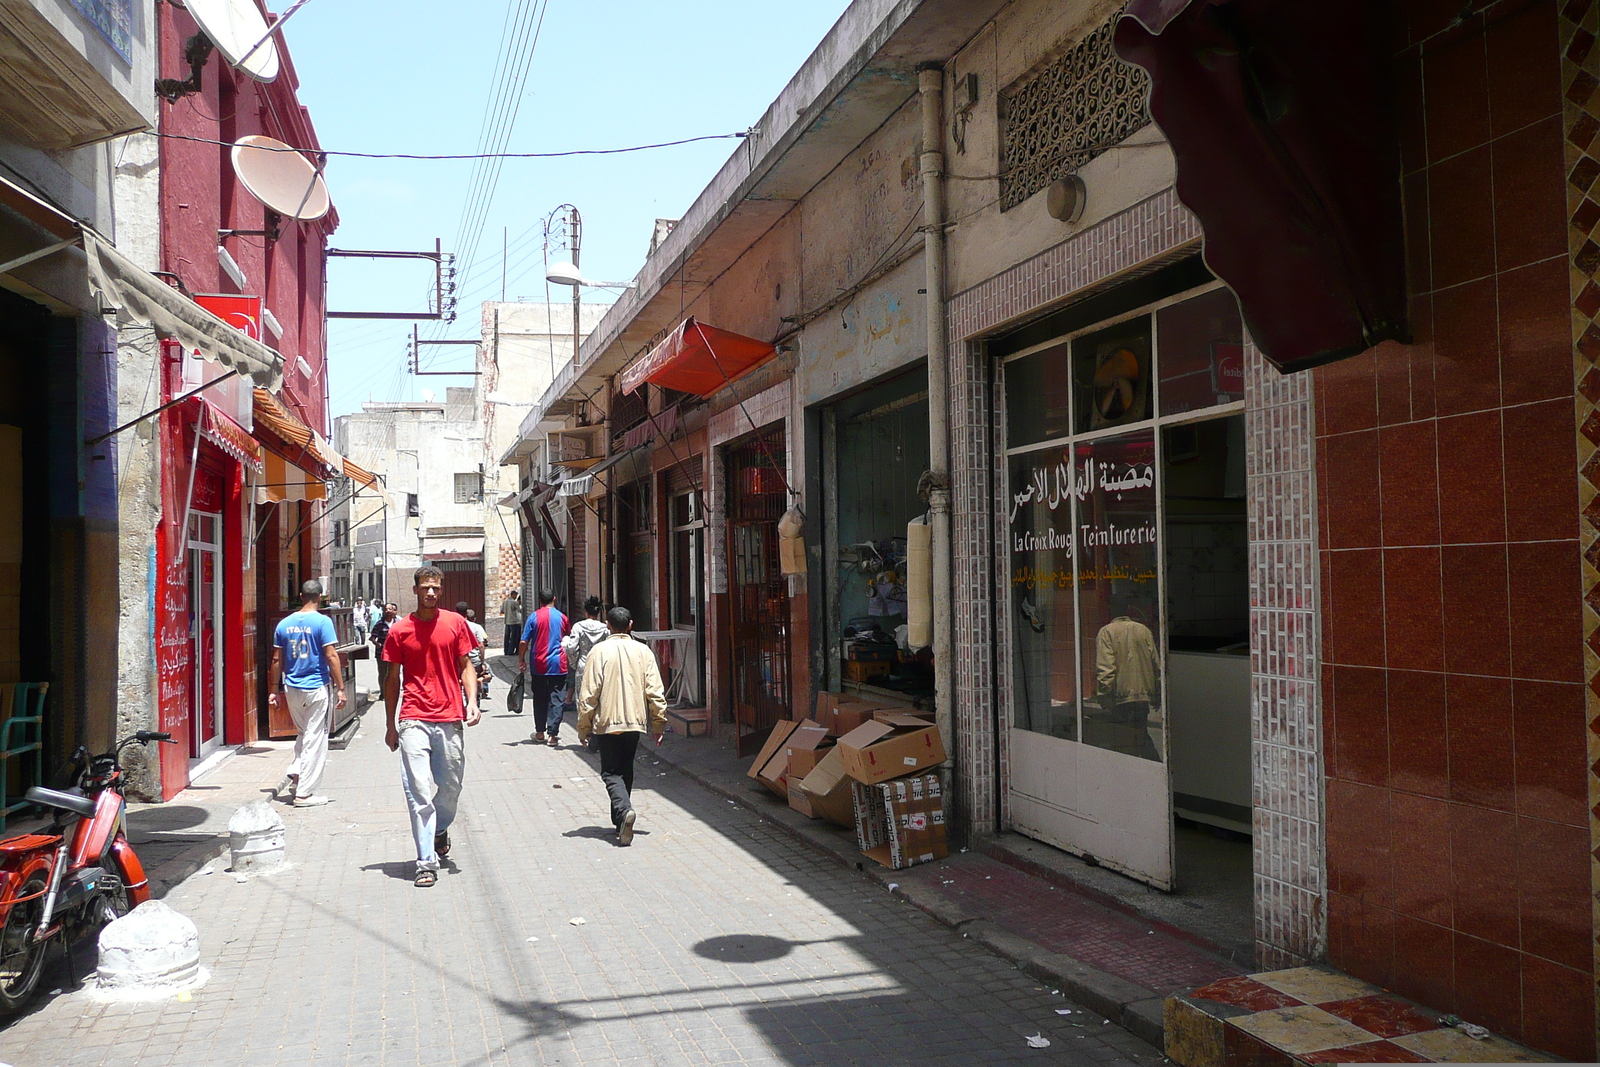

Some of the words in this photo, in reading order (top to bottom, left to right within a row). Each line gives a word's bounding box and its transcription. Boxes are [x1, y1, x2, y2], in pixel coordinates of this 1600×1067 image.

[1099, 461, 1155, 502] مصبنة
[1014, 531, 1023, 552] La
[1024, 530, 1047, 552] Croix
[1049, 527, 1074, 558] Roug
[1080, 521, 1157, 548] Teinturerie
[289, 638, 310, 660] 10
